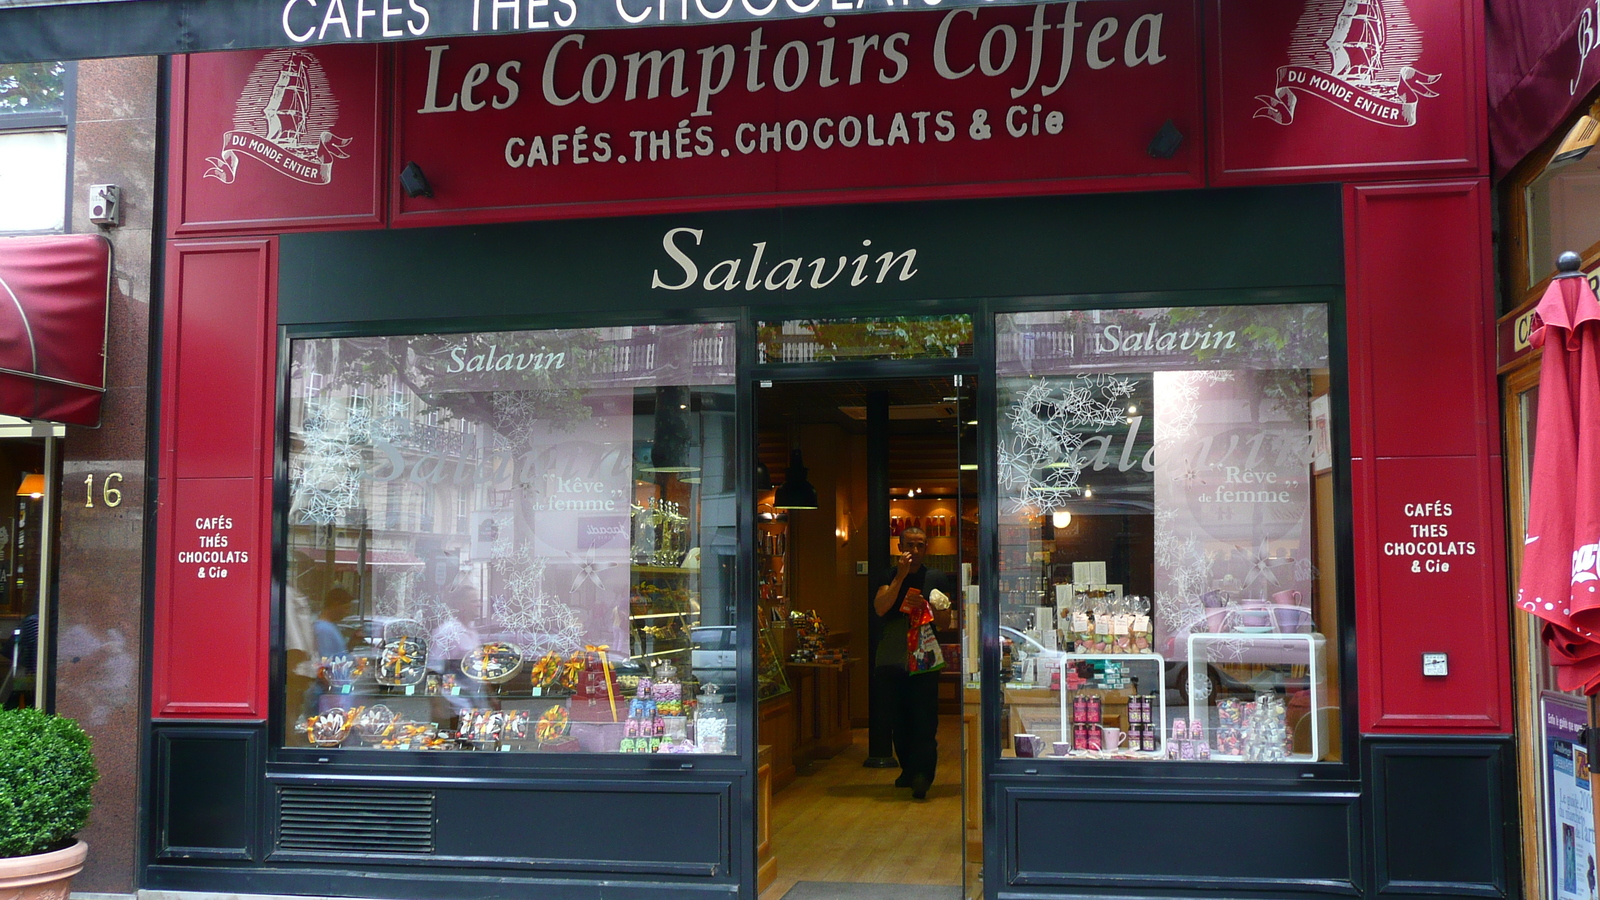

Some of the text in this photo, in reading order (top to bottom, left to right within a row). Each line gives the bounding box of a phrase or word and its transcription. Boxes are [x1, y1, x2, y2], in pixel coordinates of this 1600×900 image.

[417, 2, 1167, 118] Les Comptoirs Coffea
[1288, 70, 1400, 120] DU MONDE ENTIER
[735, 110, 955, 155] CHOCOLATS
[968, 108, 992, 141] &
[1005, 103, 1064, 138] Cie
[232, 135, 319, 179] DU MONDE ENTIER
[651, 227, 919, 292] Salavin
[1099, 322, 1237, 353] Salavin
[446, 344, 566, 373] Salavin
[84, 472, 123, 508] 16
[1198, 485, 1290, 503] de femme
[532, 494, 615, 511] de femme
[1404, 500, 1453, 517] CAFÉS
[195, 514, 233, 530] CAFÉS
[1410, 524, 1449, 538] THES
[199, 532, 229, 548] THÉS
[1384, 541, 1476, 556] CHOCOLATS
[178, 551, 249, 563] CHOCOLATS
[197, 566, 228, 579] & Cie
[1411, 559, 1450, 573] & Cie
